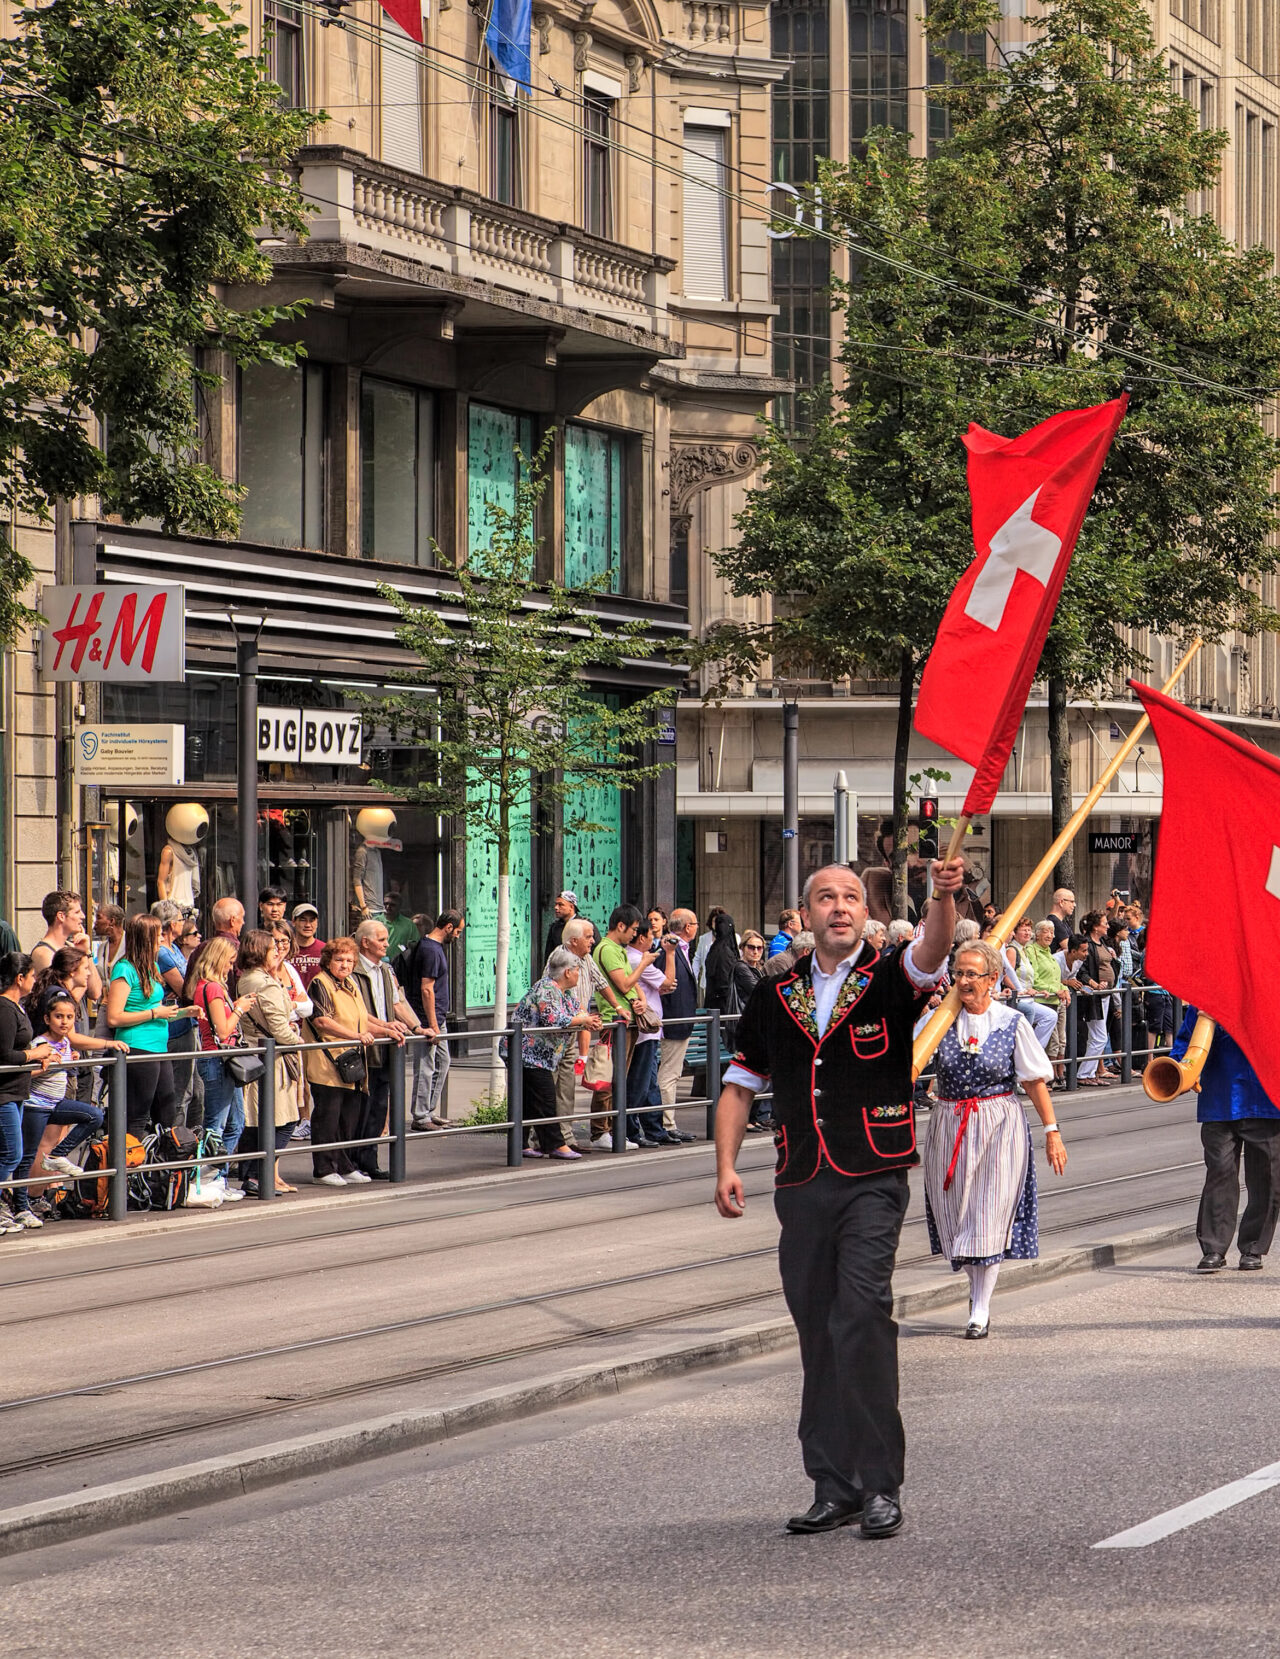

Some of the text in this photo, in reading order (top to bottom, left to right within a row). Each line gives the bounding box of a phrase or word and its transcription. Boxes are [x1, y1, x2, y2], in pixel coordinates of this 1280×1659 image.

[52, 591, 168, 674] H&M
[258, 718, 297, 753] BIG
[304, 720, 360, 755] BOYZ
[1094, 837, 1132, 850] MANOR
